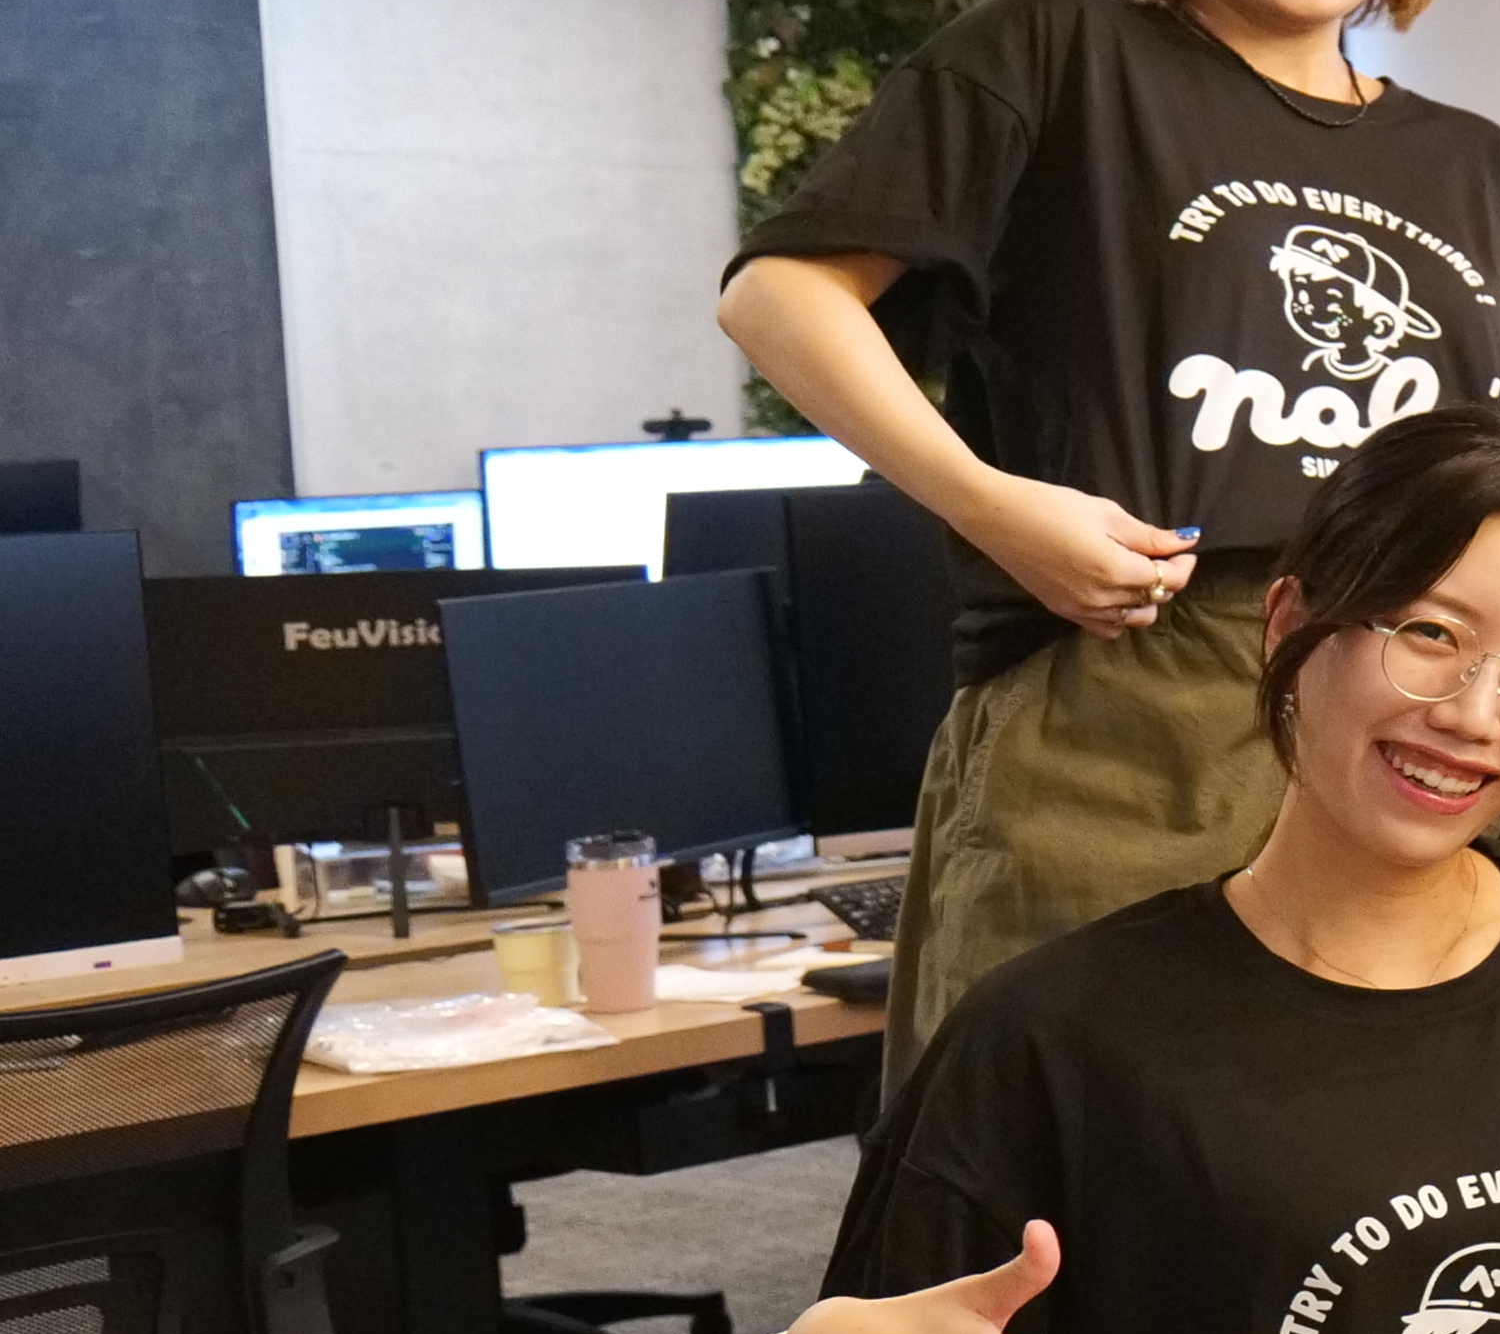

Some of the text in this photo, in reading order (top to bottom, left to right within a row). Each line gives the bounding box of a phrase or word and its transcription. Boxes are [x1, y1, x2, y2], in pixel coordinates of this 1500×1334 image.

[1169, 194, 1225, 243] TRY
[1213, 180, 1258, 207] TO
[1253, 180, 1297, 206] DO
[1168, 354, 1440, 451] nal
[283, 618, 442, 652] FeuVisi
[1331, 1215, 1391, 1266] TO
[1390, 1184, 1449, 1231] DO
